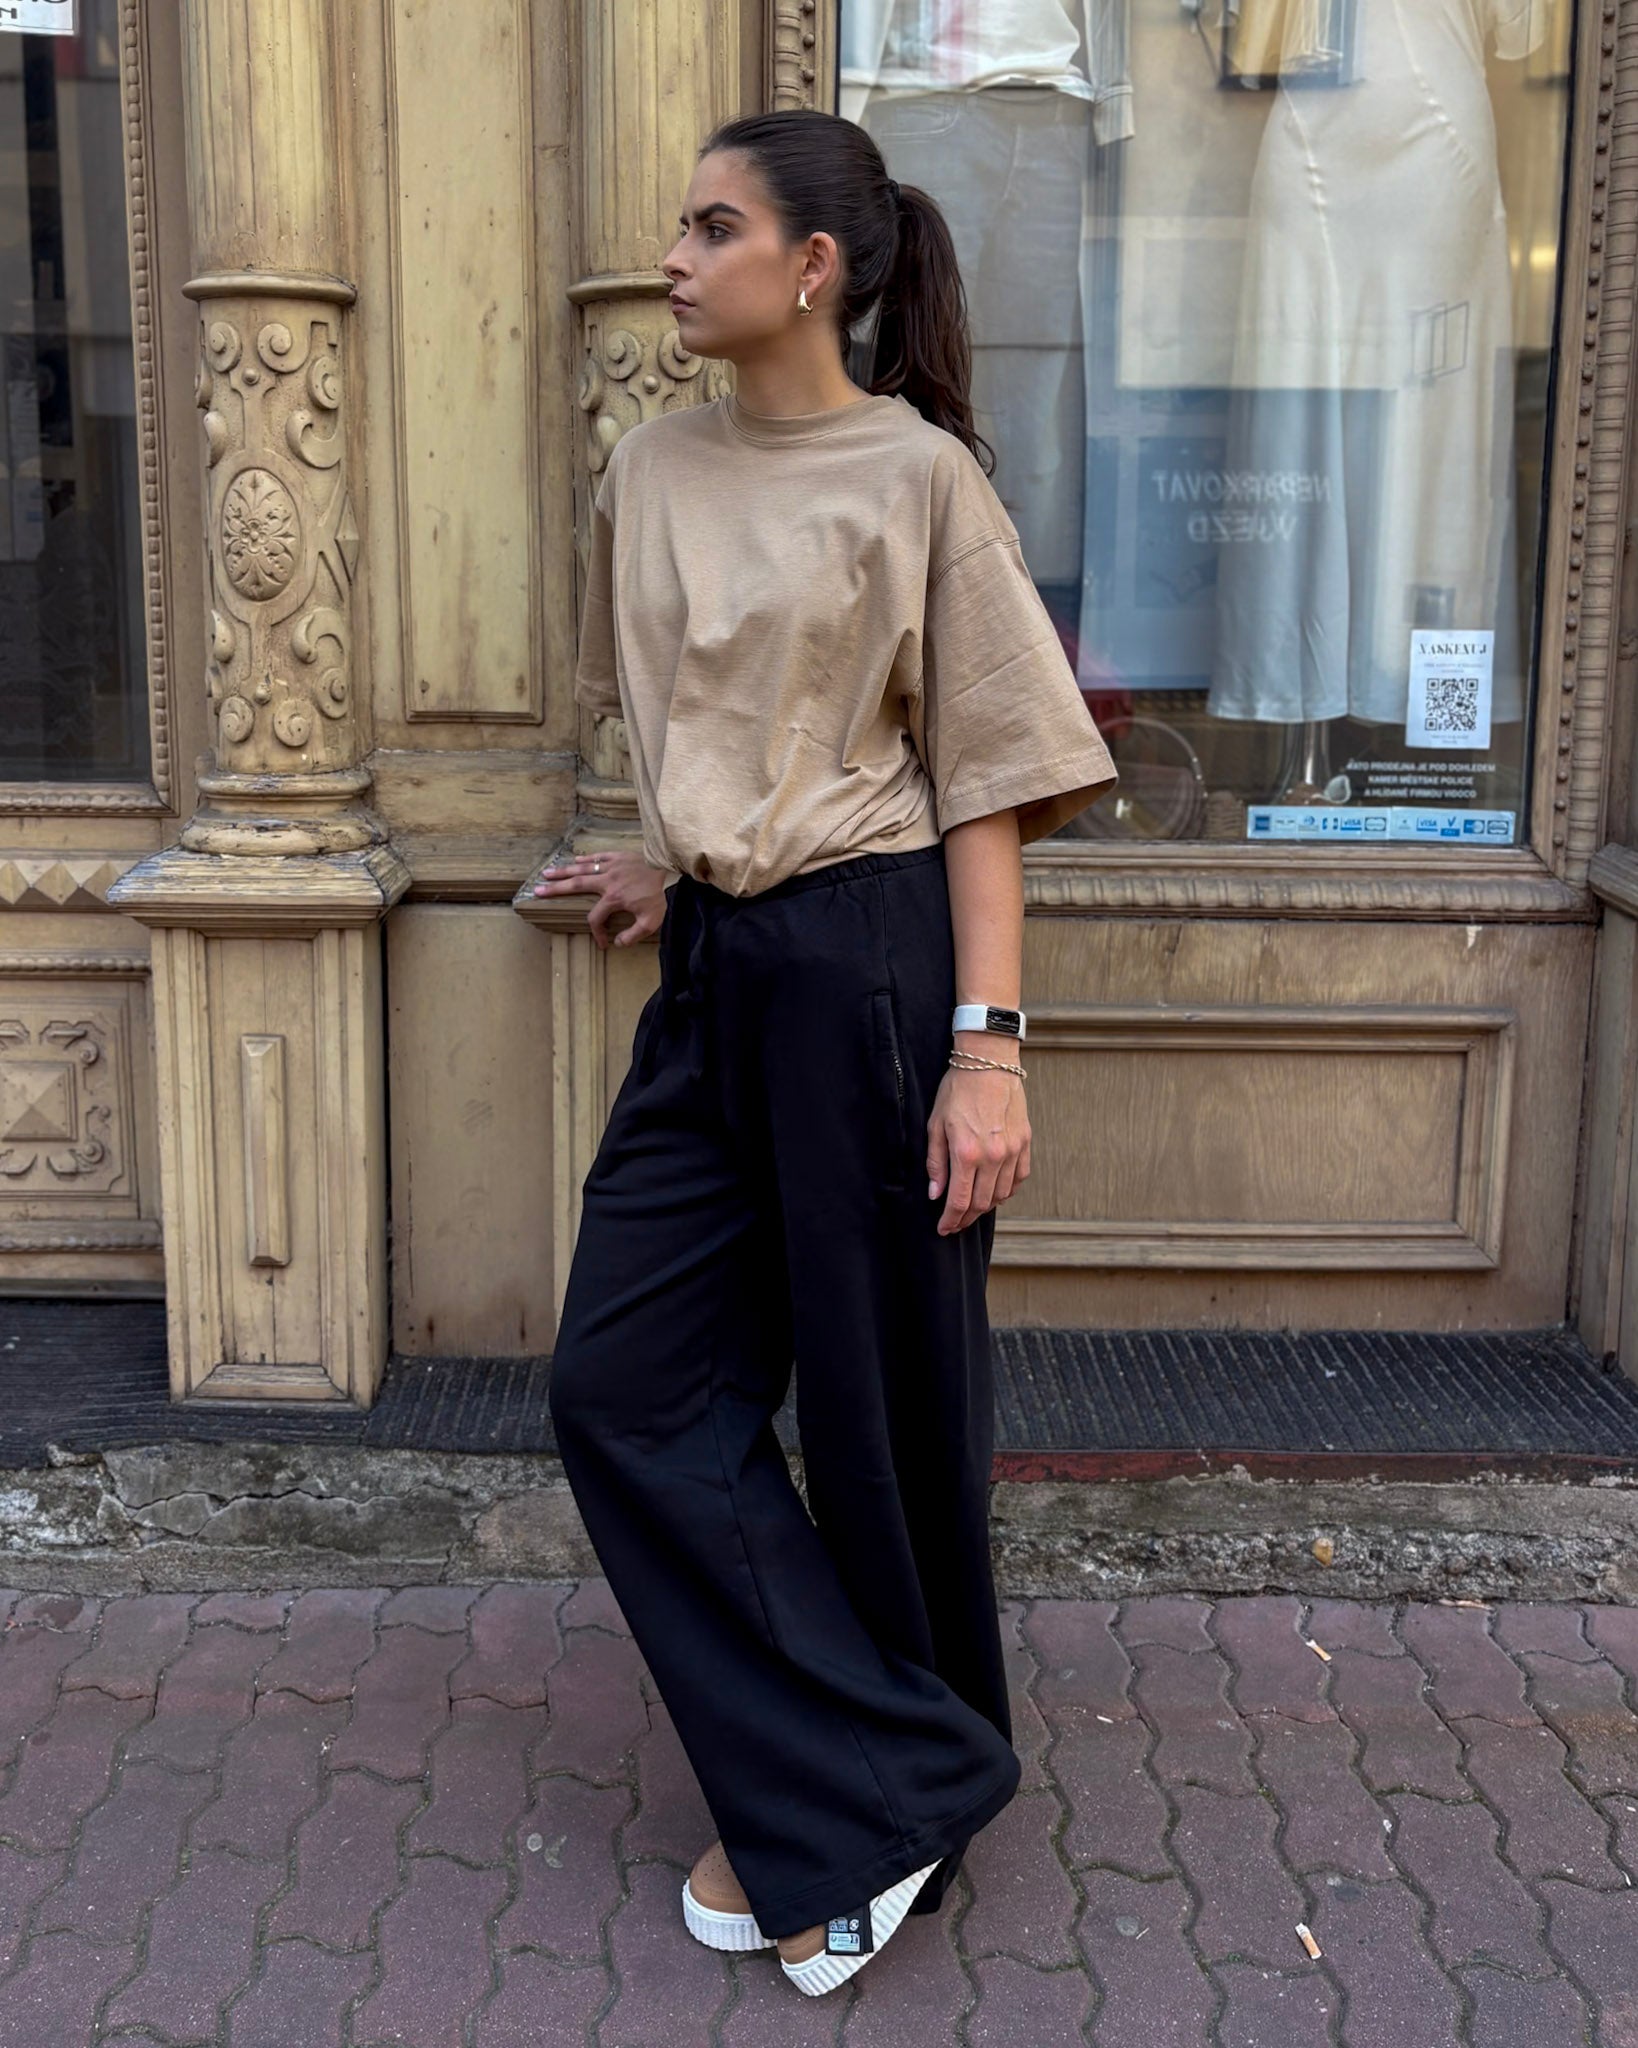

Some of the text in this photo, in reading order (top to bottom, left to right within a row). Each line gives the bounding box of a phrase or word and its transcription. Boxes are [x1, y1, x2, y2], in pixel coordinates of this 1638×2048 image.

[1429, 763, 1447, 772] POD
[1448, 763, 1496, 772] DOHLEDEM
[1440, 776, 1474, 785] POLICIE
[1410, 788, 1442, 798] FIRMOU
[1420, 819, 1437, 827] VISA
